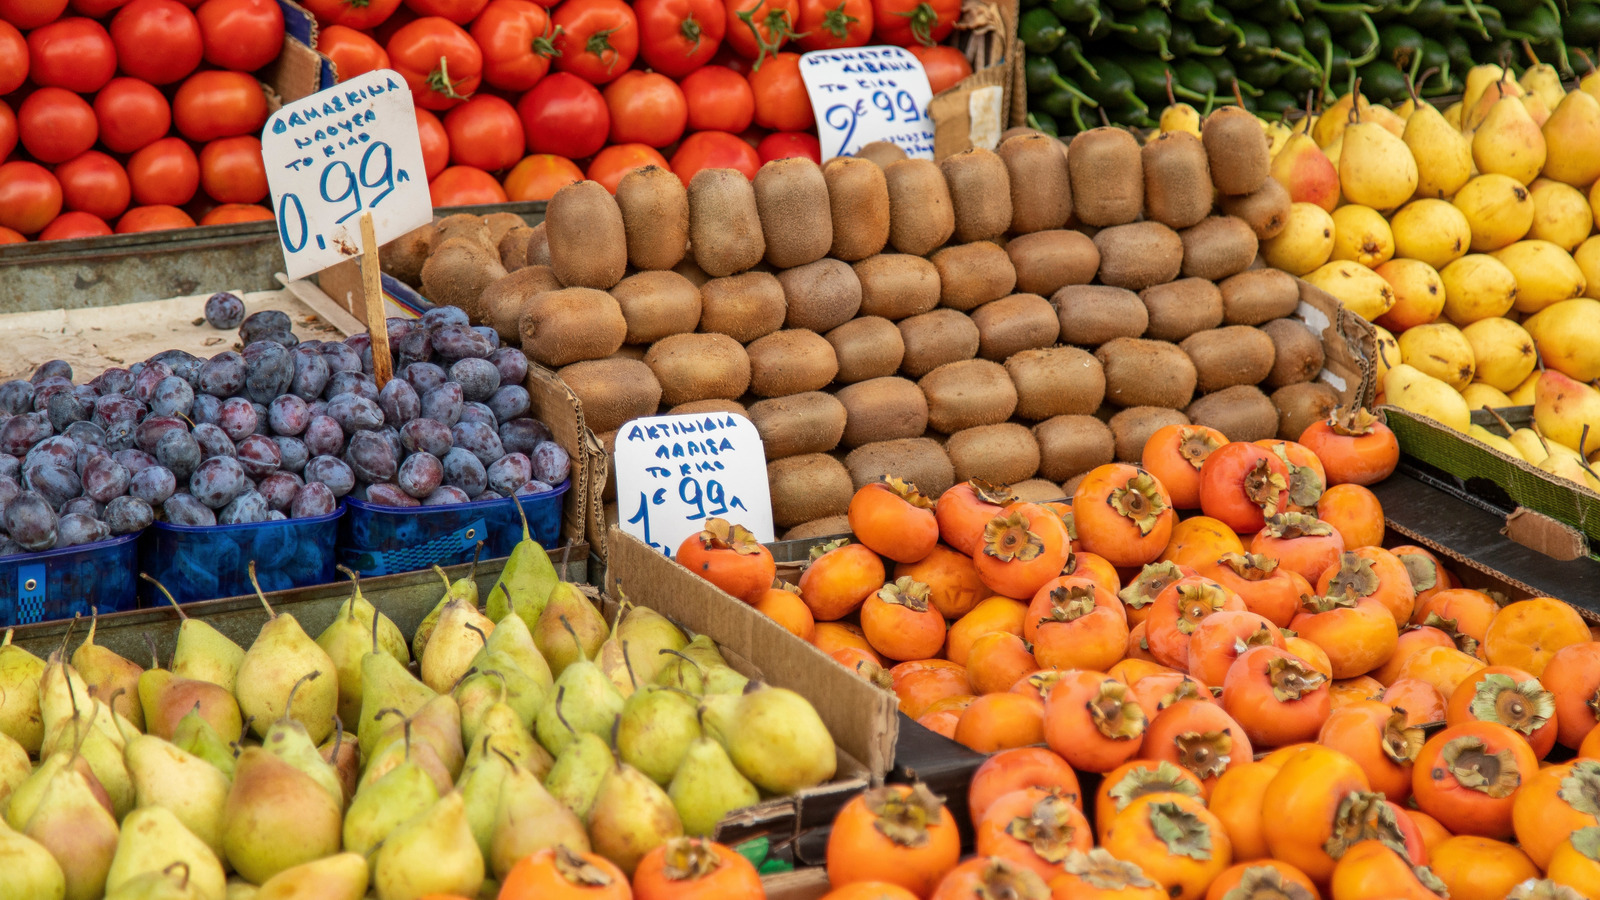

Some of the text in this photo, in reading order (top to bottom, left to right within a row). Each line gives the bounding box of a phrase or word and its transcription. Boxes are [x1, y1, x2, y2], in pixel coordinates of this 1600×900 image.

[819, 83, 848, 92] ΤΟ
[272, 77, 400, 135] ΔΑΜΑΣΚΙΝΑ
[285, 132, 371, 171] ΤΟ ΚΙΛΟ
[628, 415, 738, 442] ΑΚΤΙΝΙΔΙΑ
[645, 460, 725, 478] ΤΟ ΚΙΛΟ
